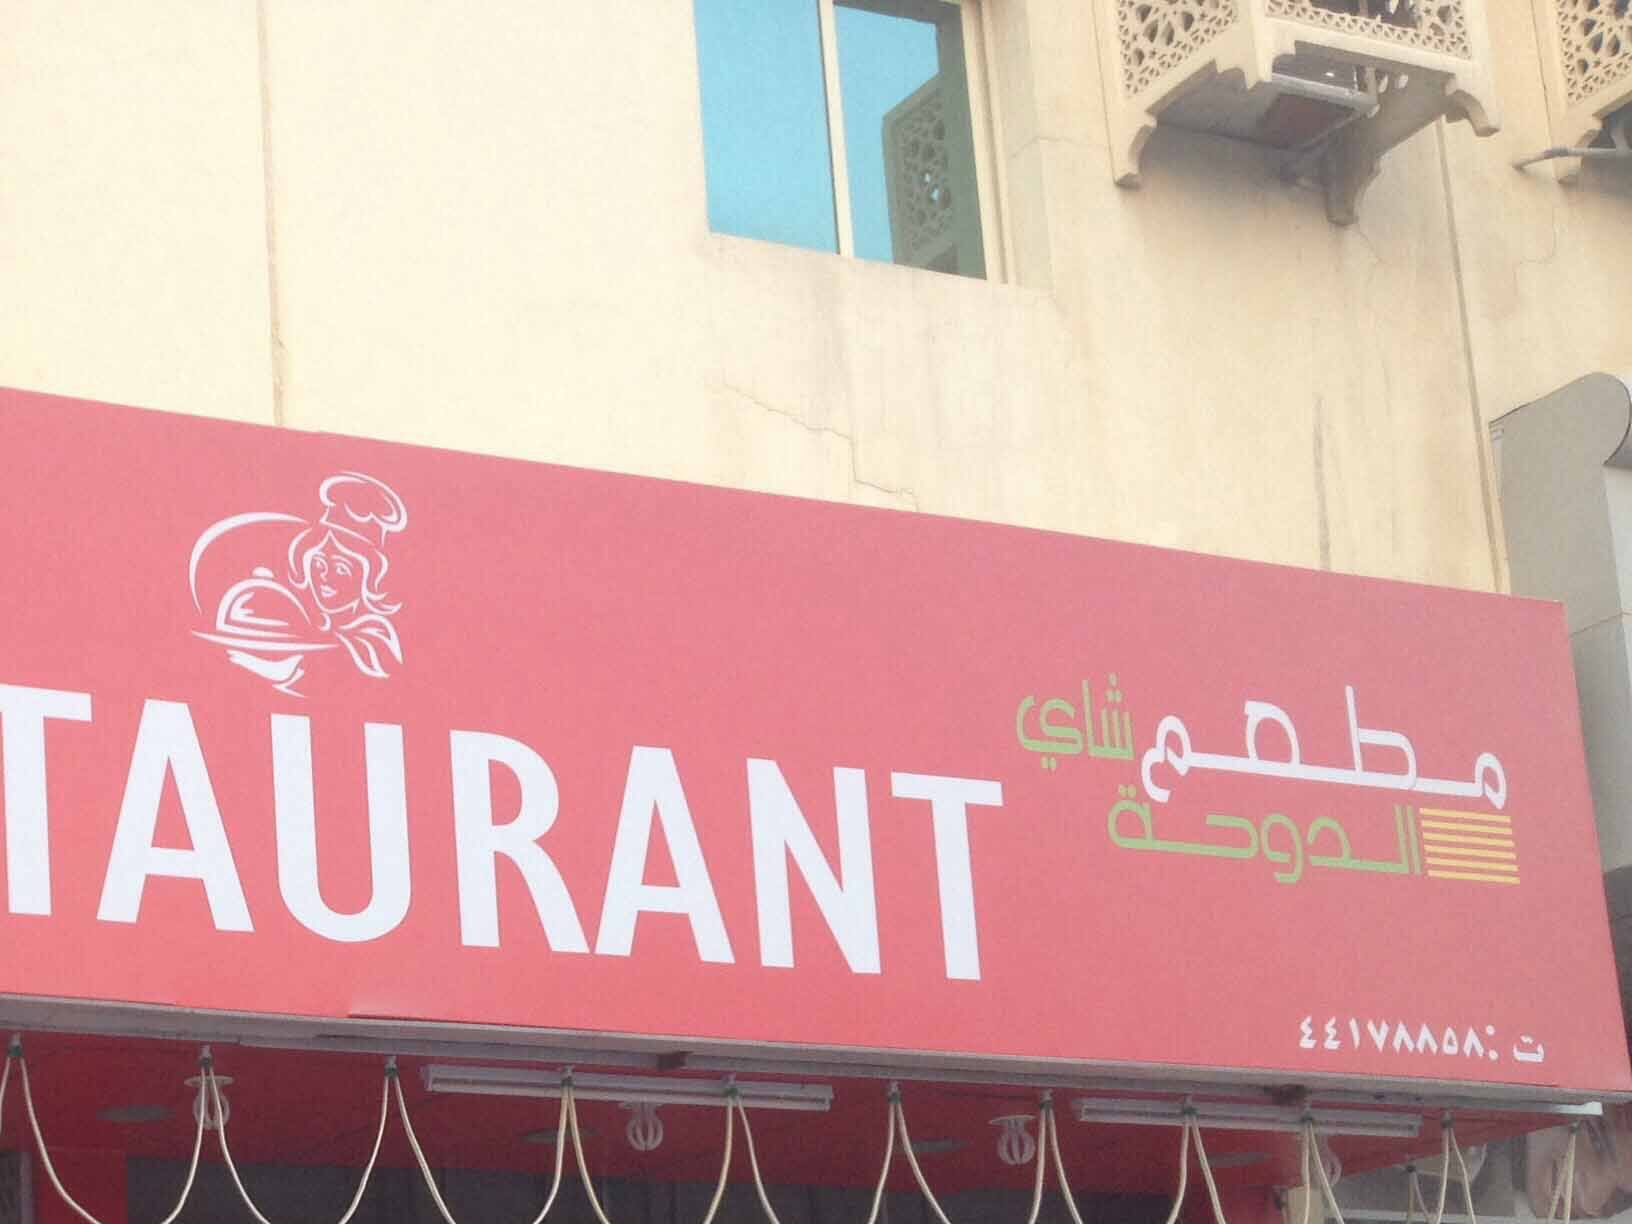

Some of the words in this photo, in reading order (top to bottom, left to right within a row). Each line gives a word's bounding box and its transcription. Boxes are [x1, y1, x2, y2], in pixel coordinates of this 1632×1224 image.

[1016, 672, 1134, 770] شاي
[1141, 685, 1507, 810] مطعم
[1107, 783, 1421, 884] الدوحة
